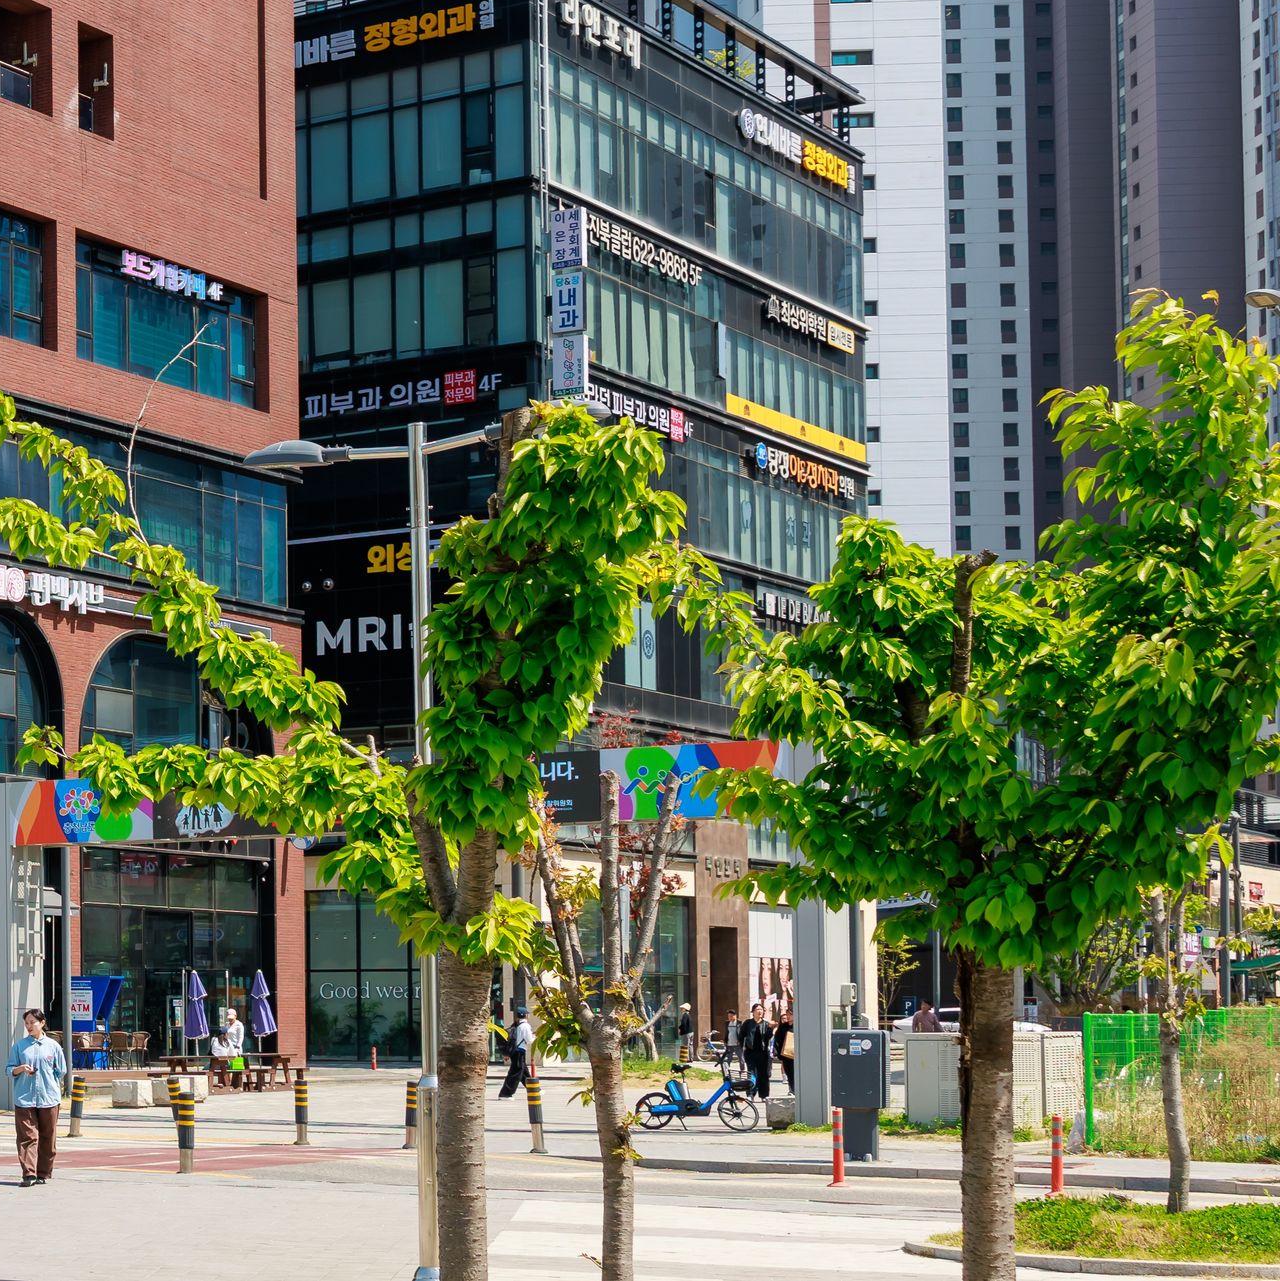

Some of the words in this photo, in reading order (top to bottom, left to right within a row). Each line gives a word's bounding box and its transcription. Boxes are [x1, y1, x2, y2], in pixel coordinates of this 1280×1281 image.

[295, 29, 357, 69] 바른
[363, 3, 476, 52] 정형외과
[479, 0, 495, 30] 의원
[753, 113, 802, 165] 연세바른
[802, 139, 848, 189] 정형외과
[554, 212, 566, 260] 이은장
[568, 209, 579, 258] 세무회계
[121, 249, 206, 301] 보드게임카페
[207, 282, 223, 301] 4F
[633, 237, 689, 283] 622-9868
[689, 265, 703, 286] 5F
[558, 288, 579, 328] 내과
[781, 300, 827, 342] 최상위학원
[304, 386, 383, 418] 피부과
[389, 377, 441, 406] 의원
[444, 371, 476, 386] 피부과
[444, 386, 476, 404] 전문의
[478, 373, 502, 392] 4F
[612, 391, 647, 424] 피부과
[648, 406, 670, 432] 의원
[684, 421, 694, 437] 4F
[29, 571, 105, 615] 편백샤브
[789, 598, 801, 623] DE
[316, 613, 402, 656] MRI
[71, 1004, 90, 1012] ATM
[320, 979, 370, 1001] Good
